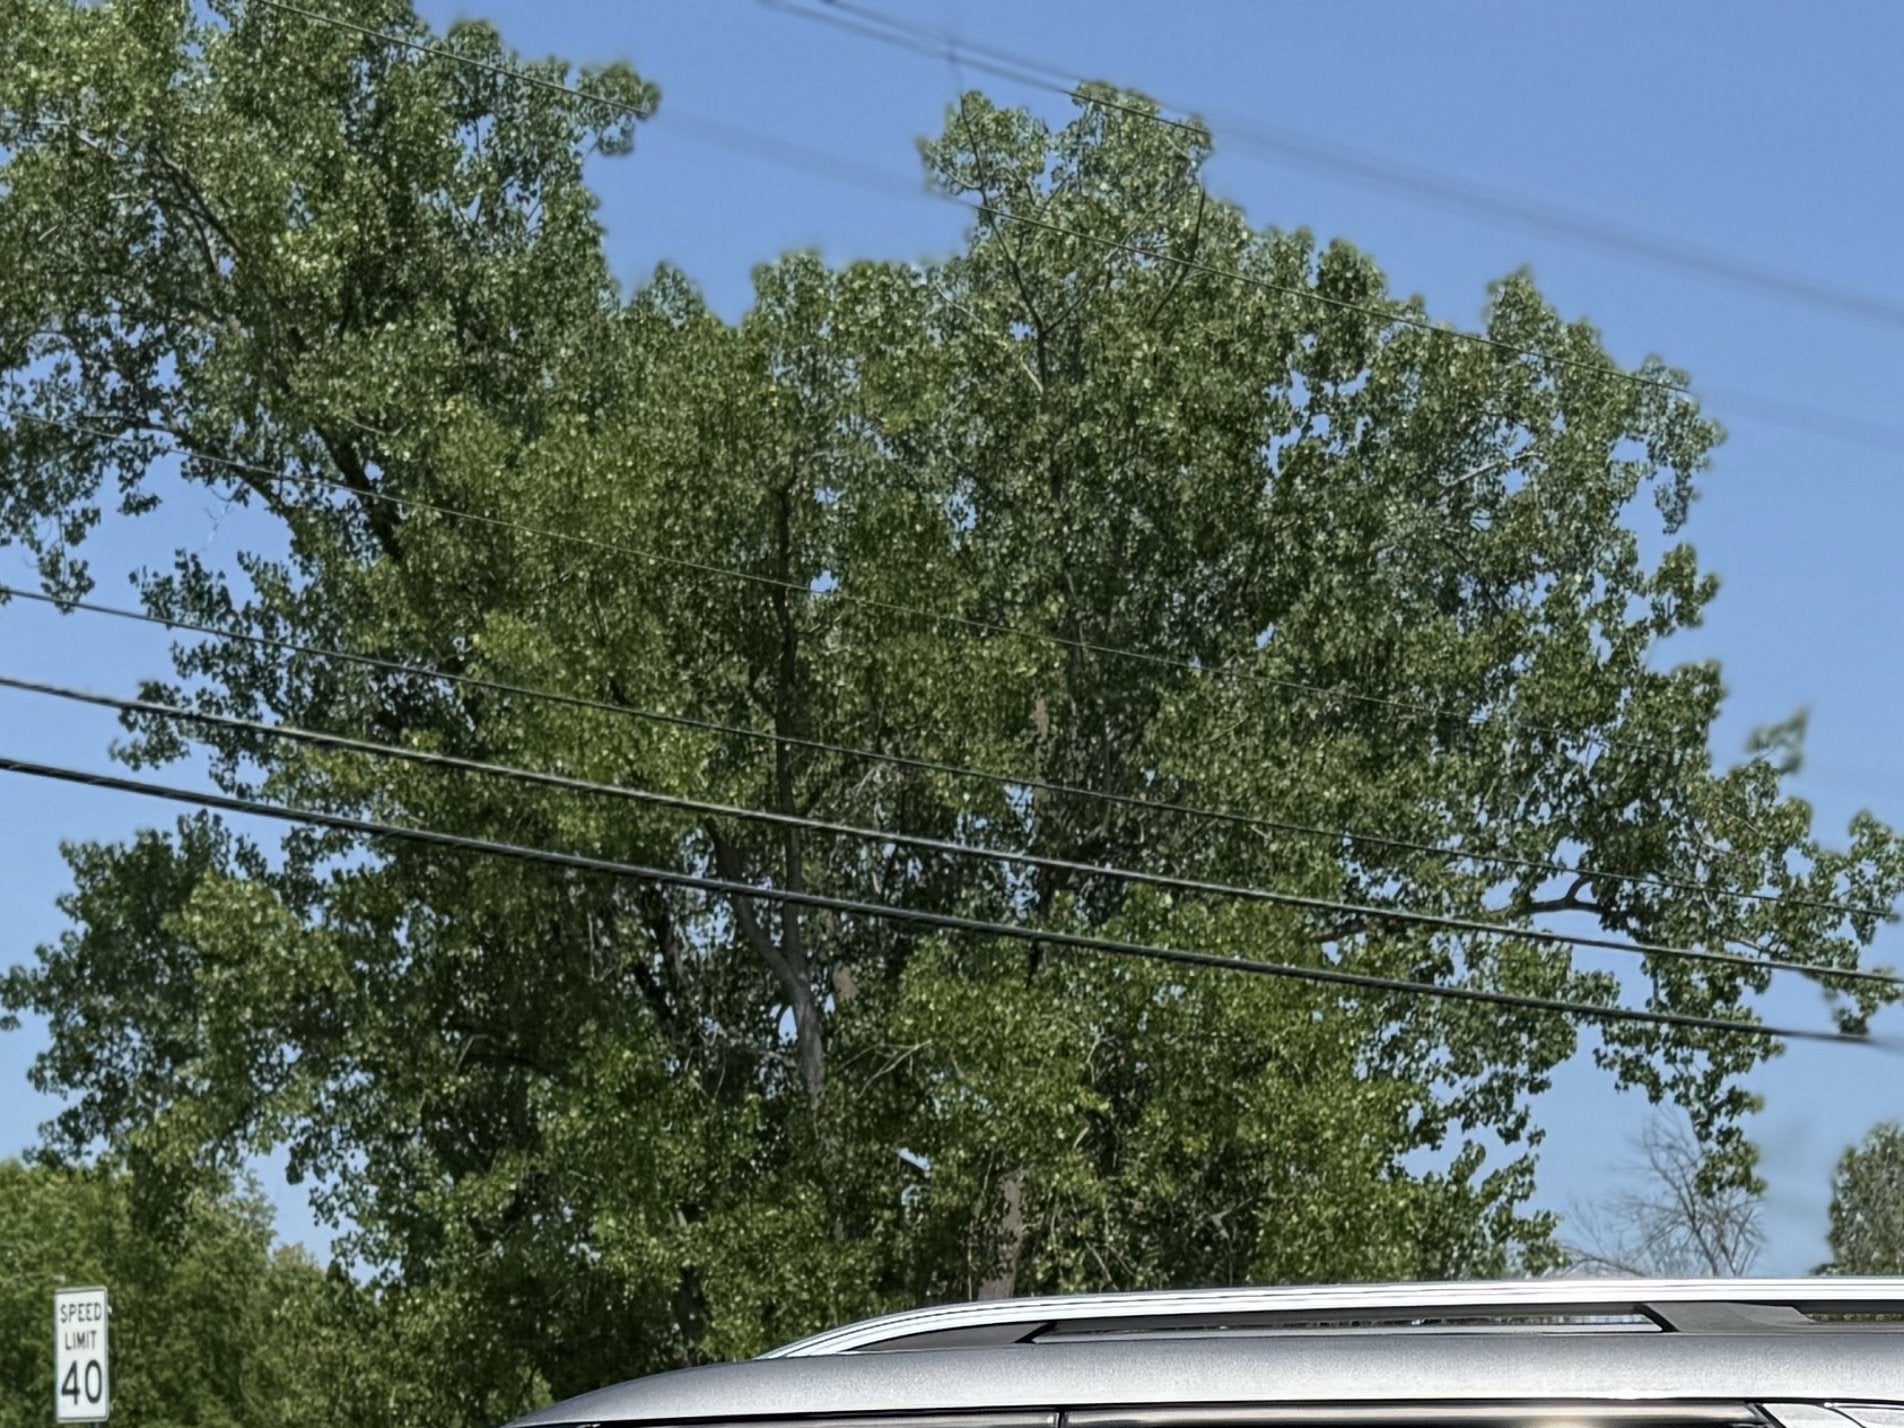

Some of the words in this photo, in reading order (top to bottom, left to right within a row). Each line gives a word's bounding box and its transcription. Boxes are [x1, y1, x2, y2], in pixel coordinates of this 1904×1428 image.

[60, 1302, 102, 1324] SPEED
[64, 1330, 97, 1351] LIMIT
[61, 1358, 103, 1406] 40
